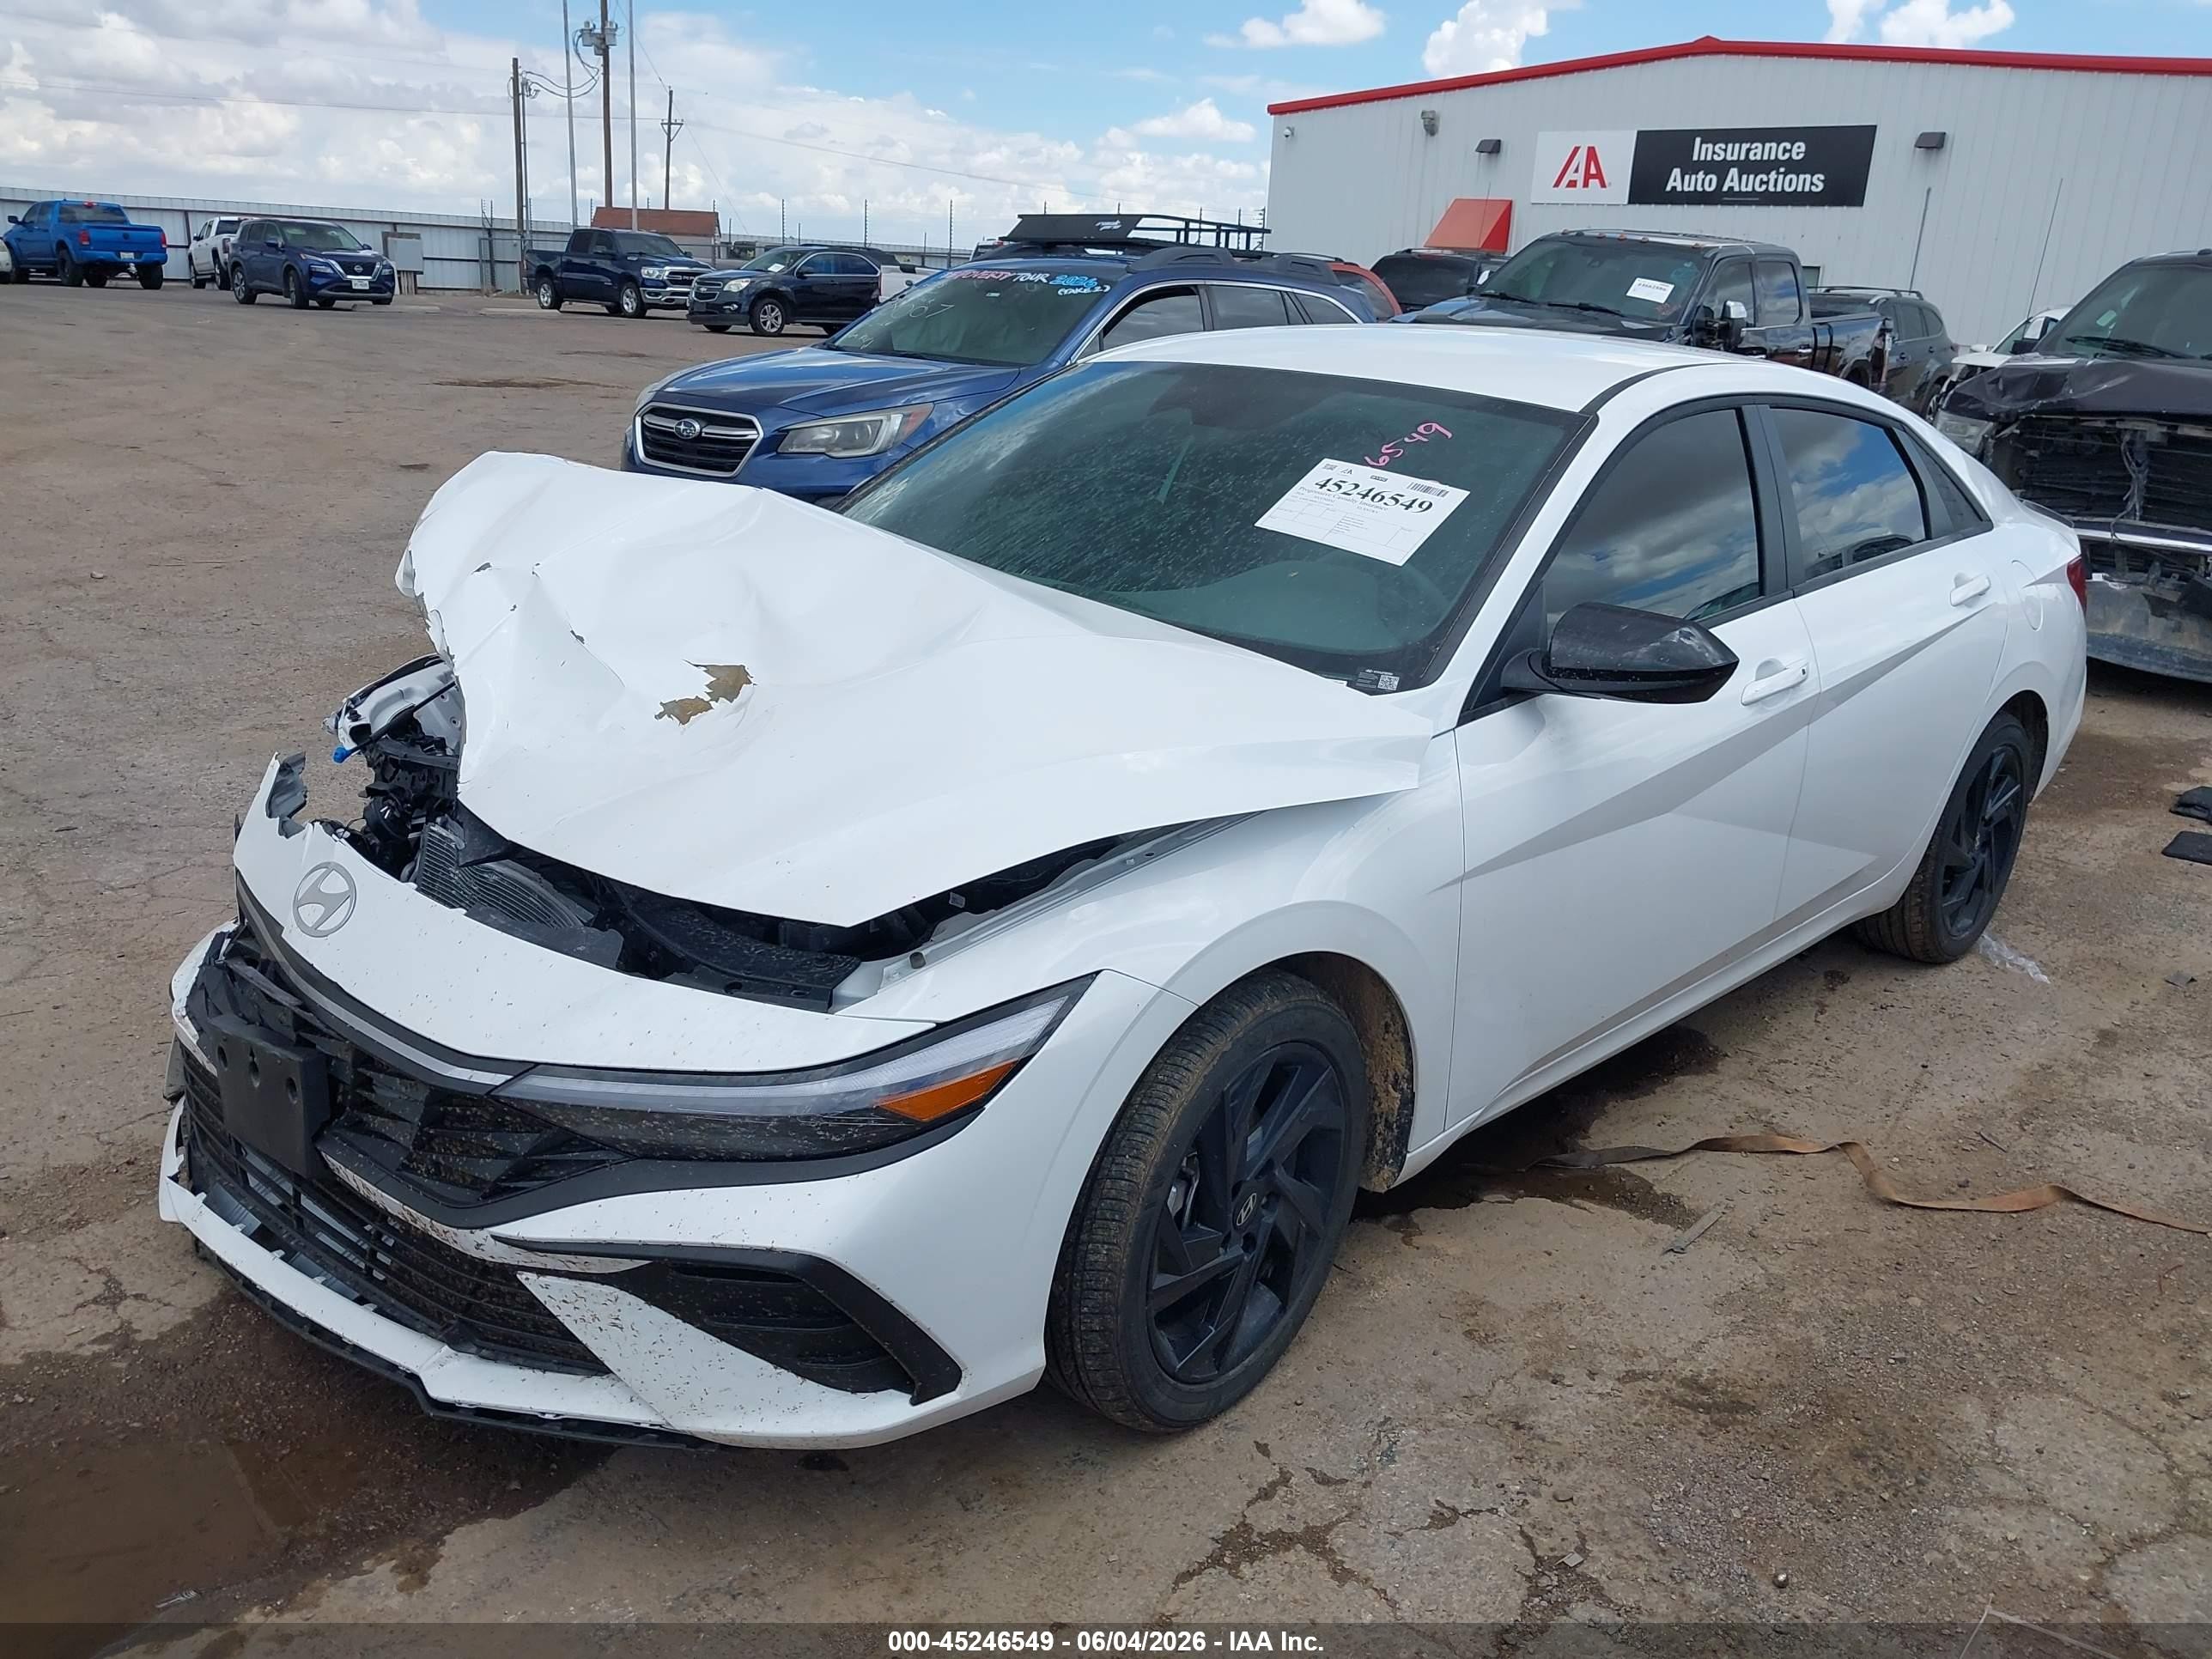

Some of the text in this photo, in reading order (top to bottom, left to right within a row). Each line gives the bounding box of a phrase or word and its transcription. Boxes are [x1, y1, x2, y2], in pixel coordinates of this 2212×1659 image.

[1692, 137, 1806, 161] Insurance
[1665, 167, 1826, 193] Auto Auctions
[1012, 272, 1050, 283] TOUR
[1049, 275, 1099, 289] 2026
[1364, 422, 1453, 466] 6549
[1314, 477, 1433, 514] 45246549
